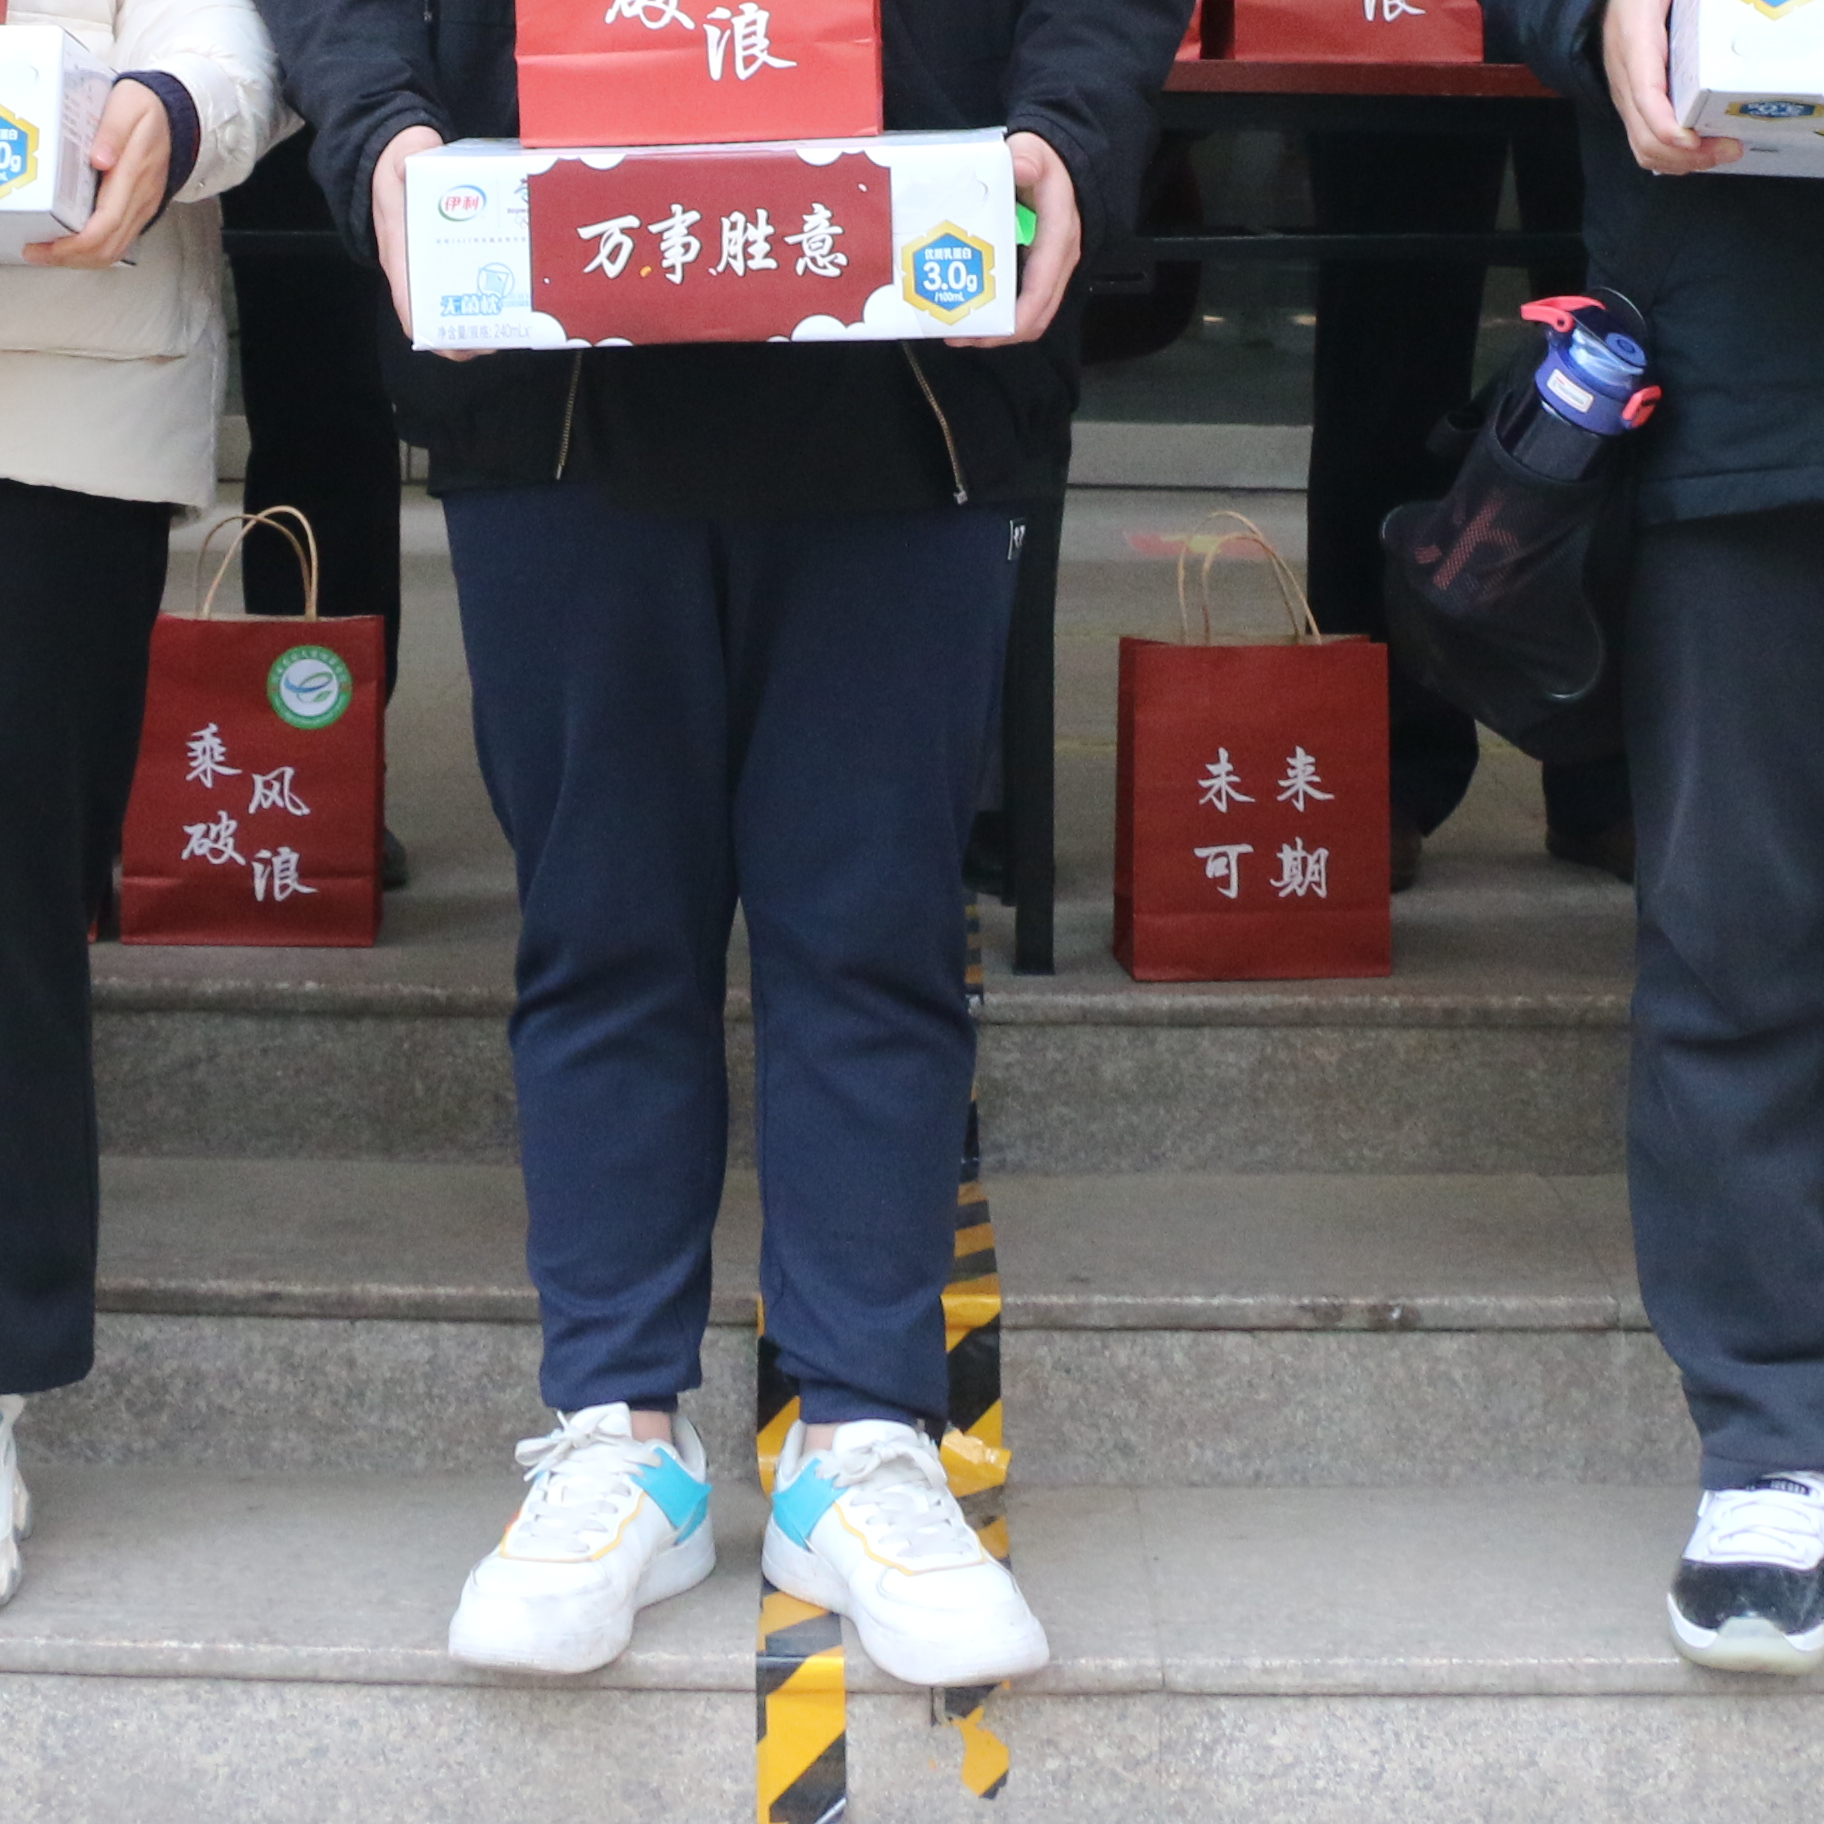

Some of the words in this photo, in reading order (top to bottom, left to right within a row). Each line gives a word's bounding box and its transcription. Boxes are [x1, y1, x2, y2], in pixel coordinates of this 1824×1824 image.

[444, 195, 480, 212] 伊利
[576, 202, 849, 284] 万事胜意
[922, 260, 978, 293] 3.0g
[934, 291, 966, 303] /100mL
[185, 722, 310, 818] 乘风
[1197, 745, 1336, 814] 未来
[181, 811, 318, 902] 破浪
[1193, 835, 1330, 900] 可期
